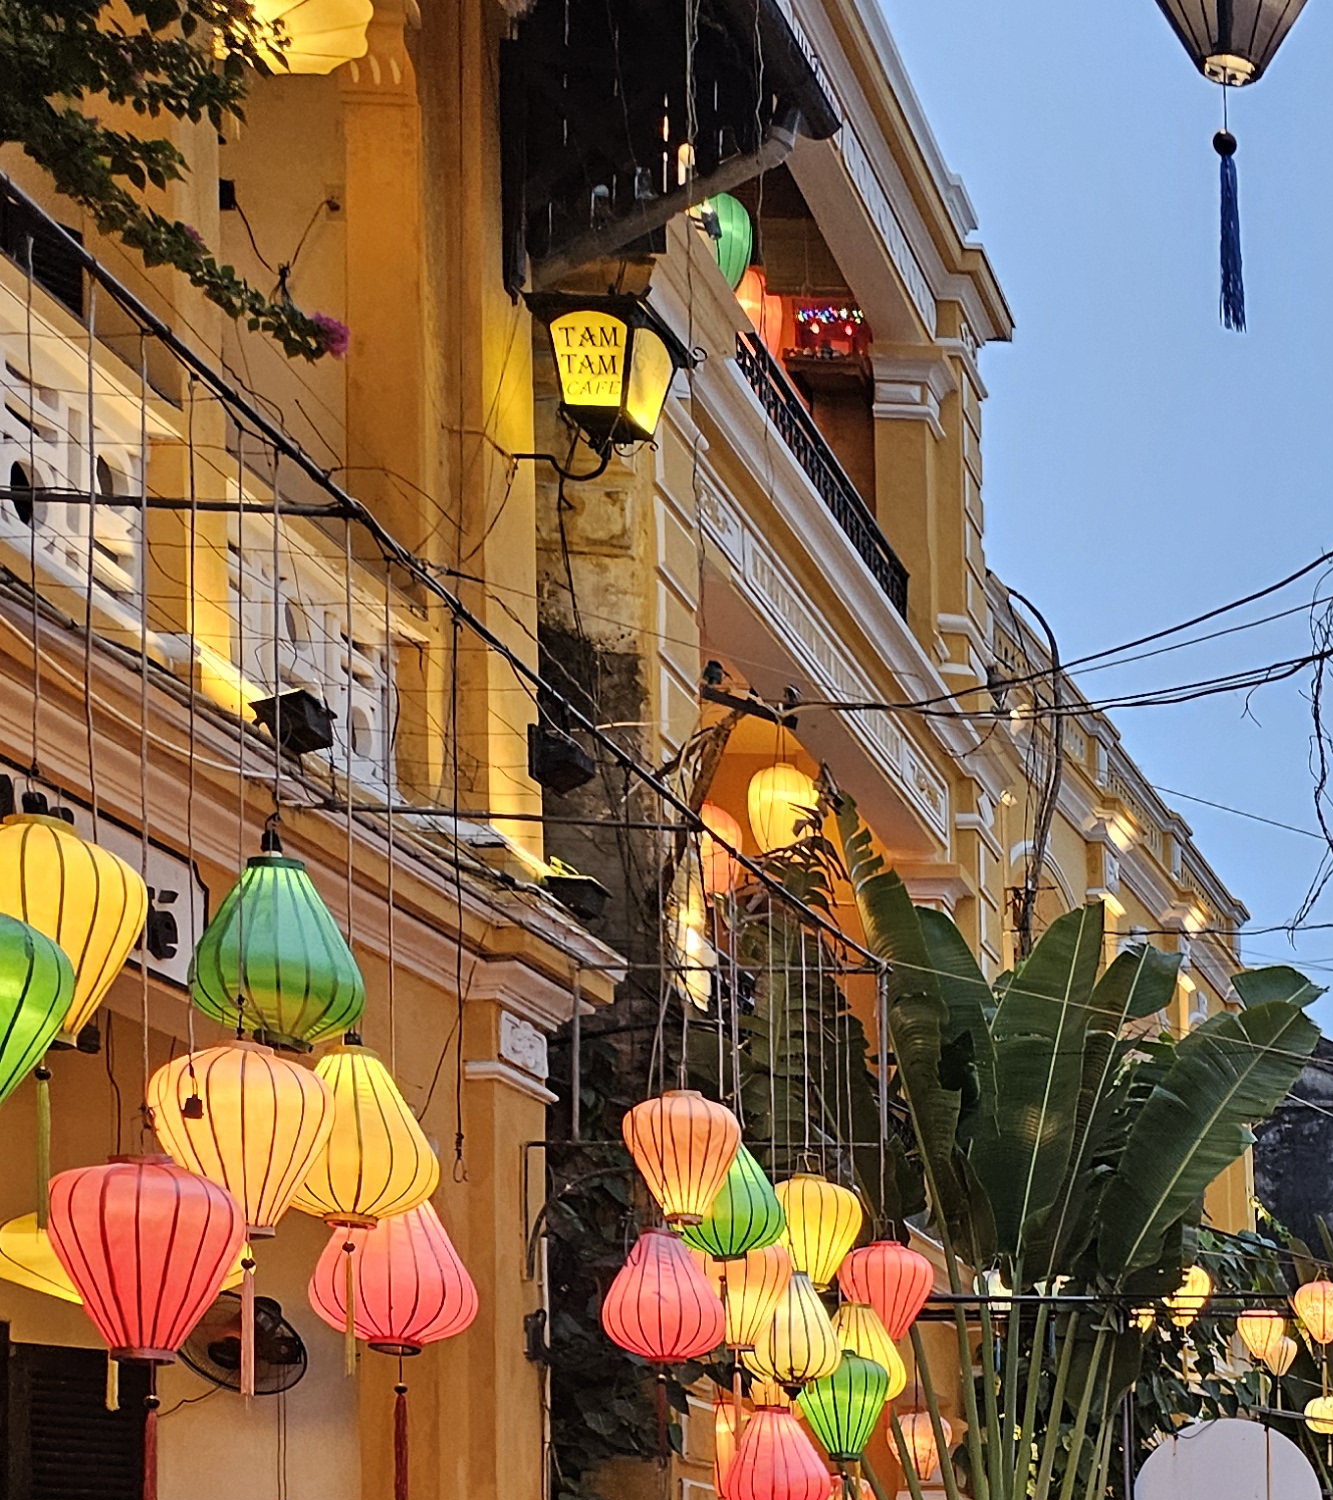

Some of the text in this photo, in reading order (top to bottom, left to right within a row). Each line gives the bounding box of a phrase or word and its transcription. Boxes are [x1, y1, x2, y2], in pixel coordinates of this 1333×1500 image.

[558, 326, 621, 348] TAM
[560, 353, 618, 375] TAM
[566, 380, 621, 396] CAFE
